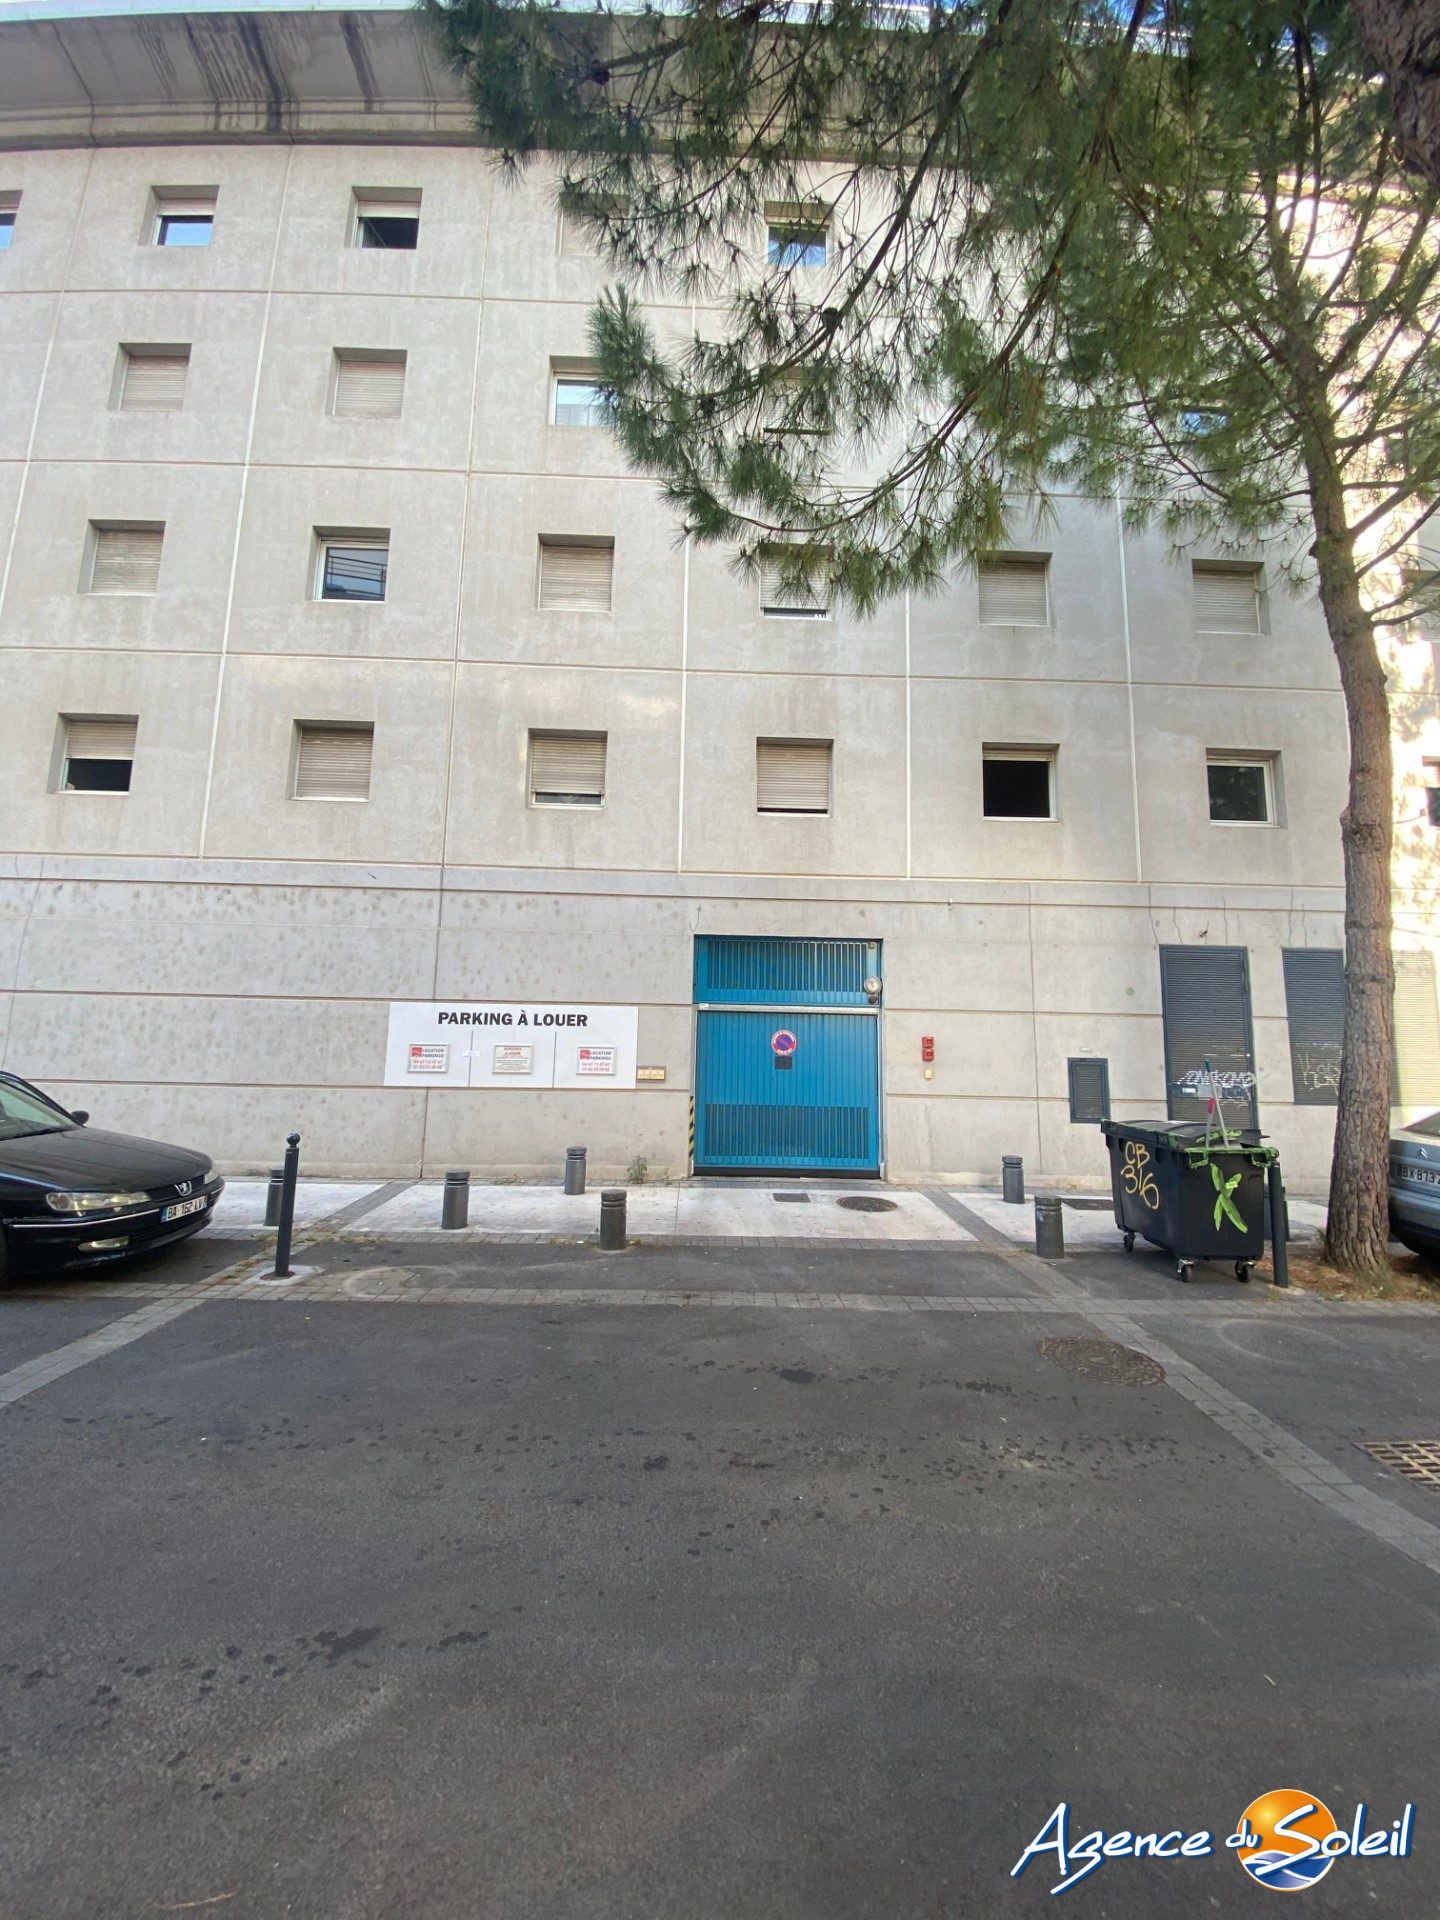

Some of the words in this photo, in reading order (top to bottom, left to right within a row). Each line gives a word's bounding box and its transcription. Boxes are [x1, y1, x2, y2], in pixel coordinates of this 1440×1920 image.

[438, 1012, 513, 1025] PARKING
[517, 1010, 529, 1026] À
[533, 1013, 588, 1027] LOUER
[1125, 1141, 1150, 1169] CB
[1120, 1165, 1159, 1210] 316
